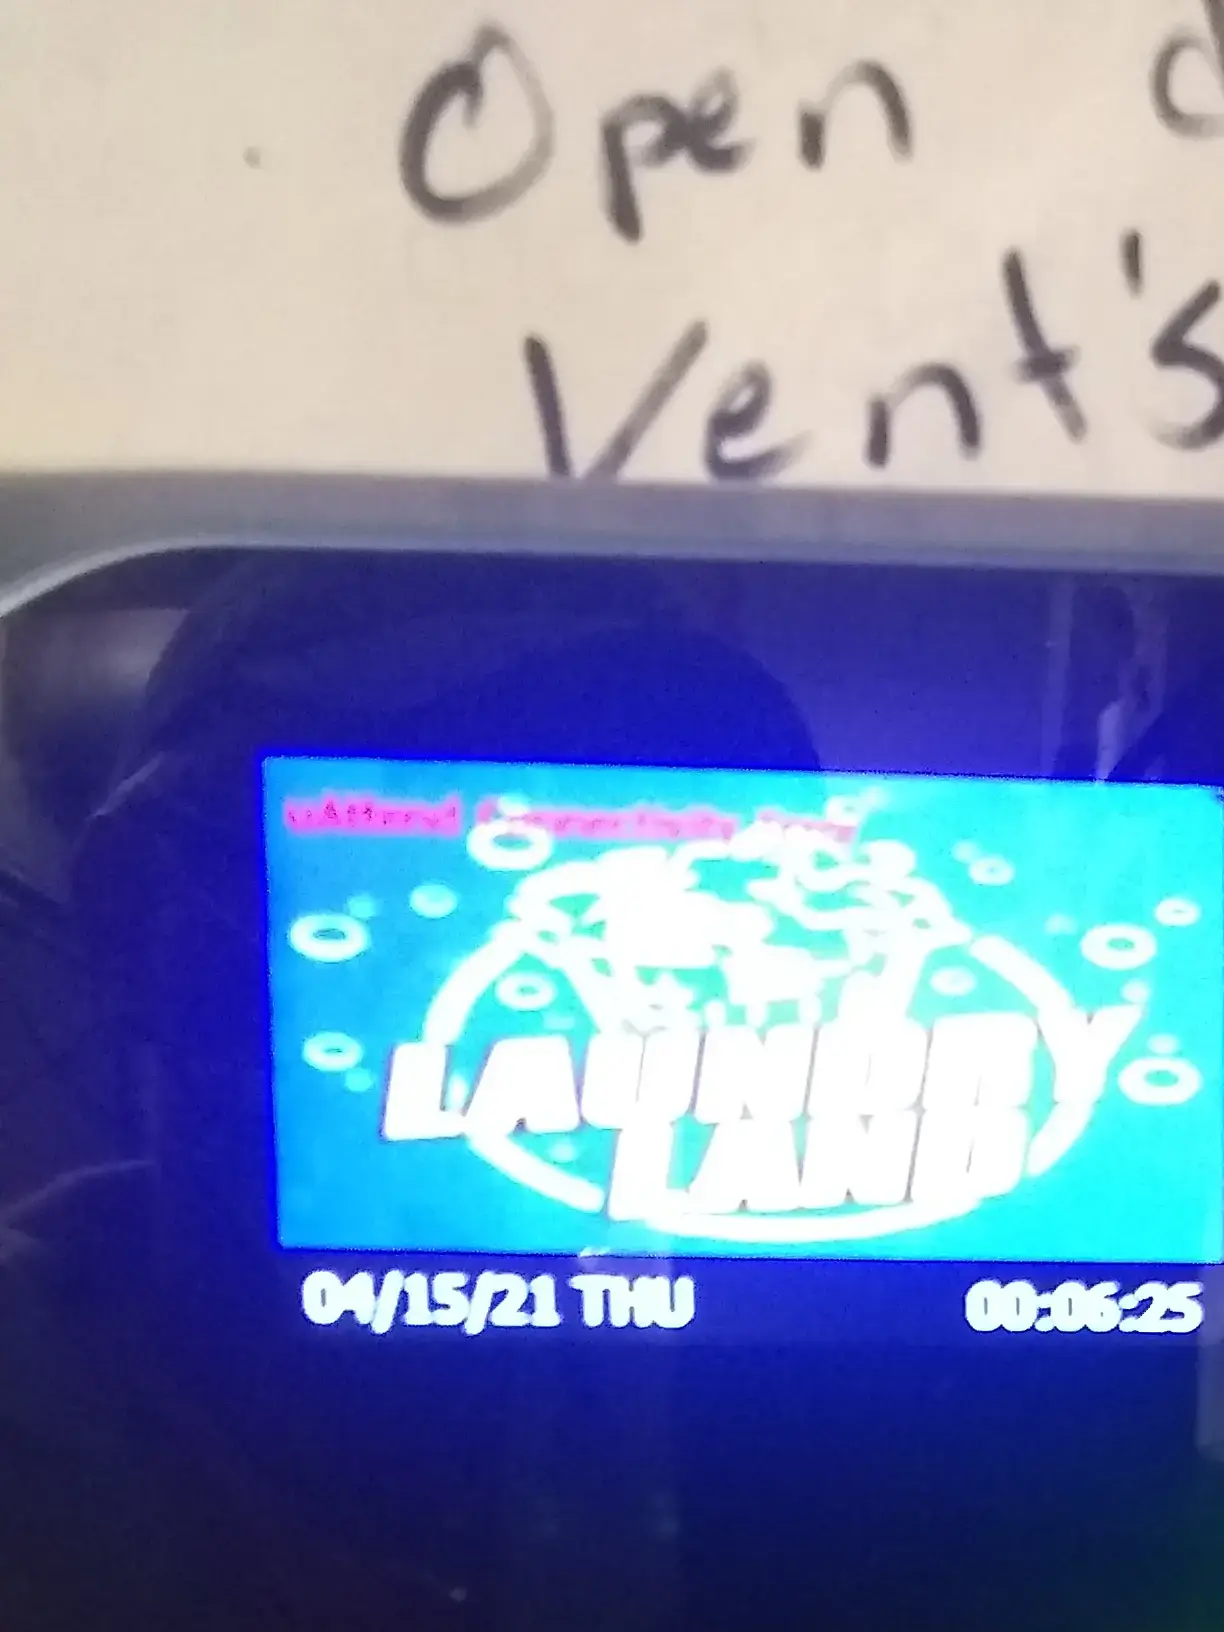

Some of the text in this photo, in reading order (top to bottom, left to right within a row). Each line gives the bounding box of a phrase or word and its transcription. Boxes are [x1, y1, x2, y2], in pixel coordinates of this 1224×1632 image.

[400, 20, 914, 241] Open
[382, 1003, 1145, 1142] LAUNDRY
[606, 1100, 1030, 1222] LAND
[302, 1269, 1205, 1336] 04/15/21 THU 00:06:25
